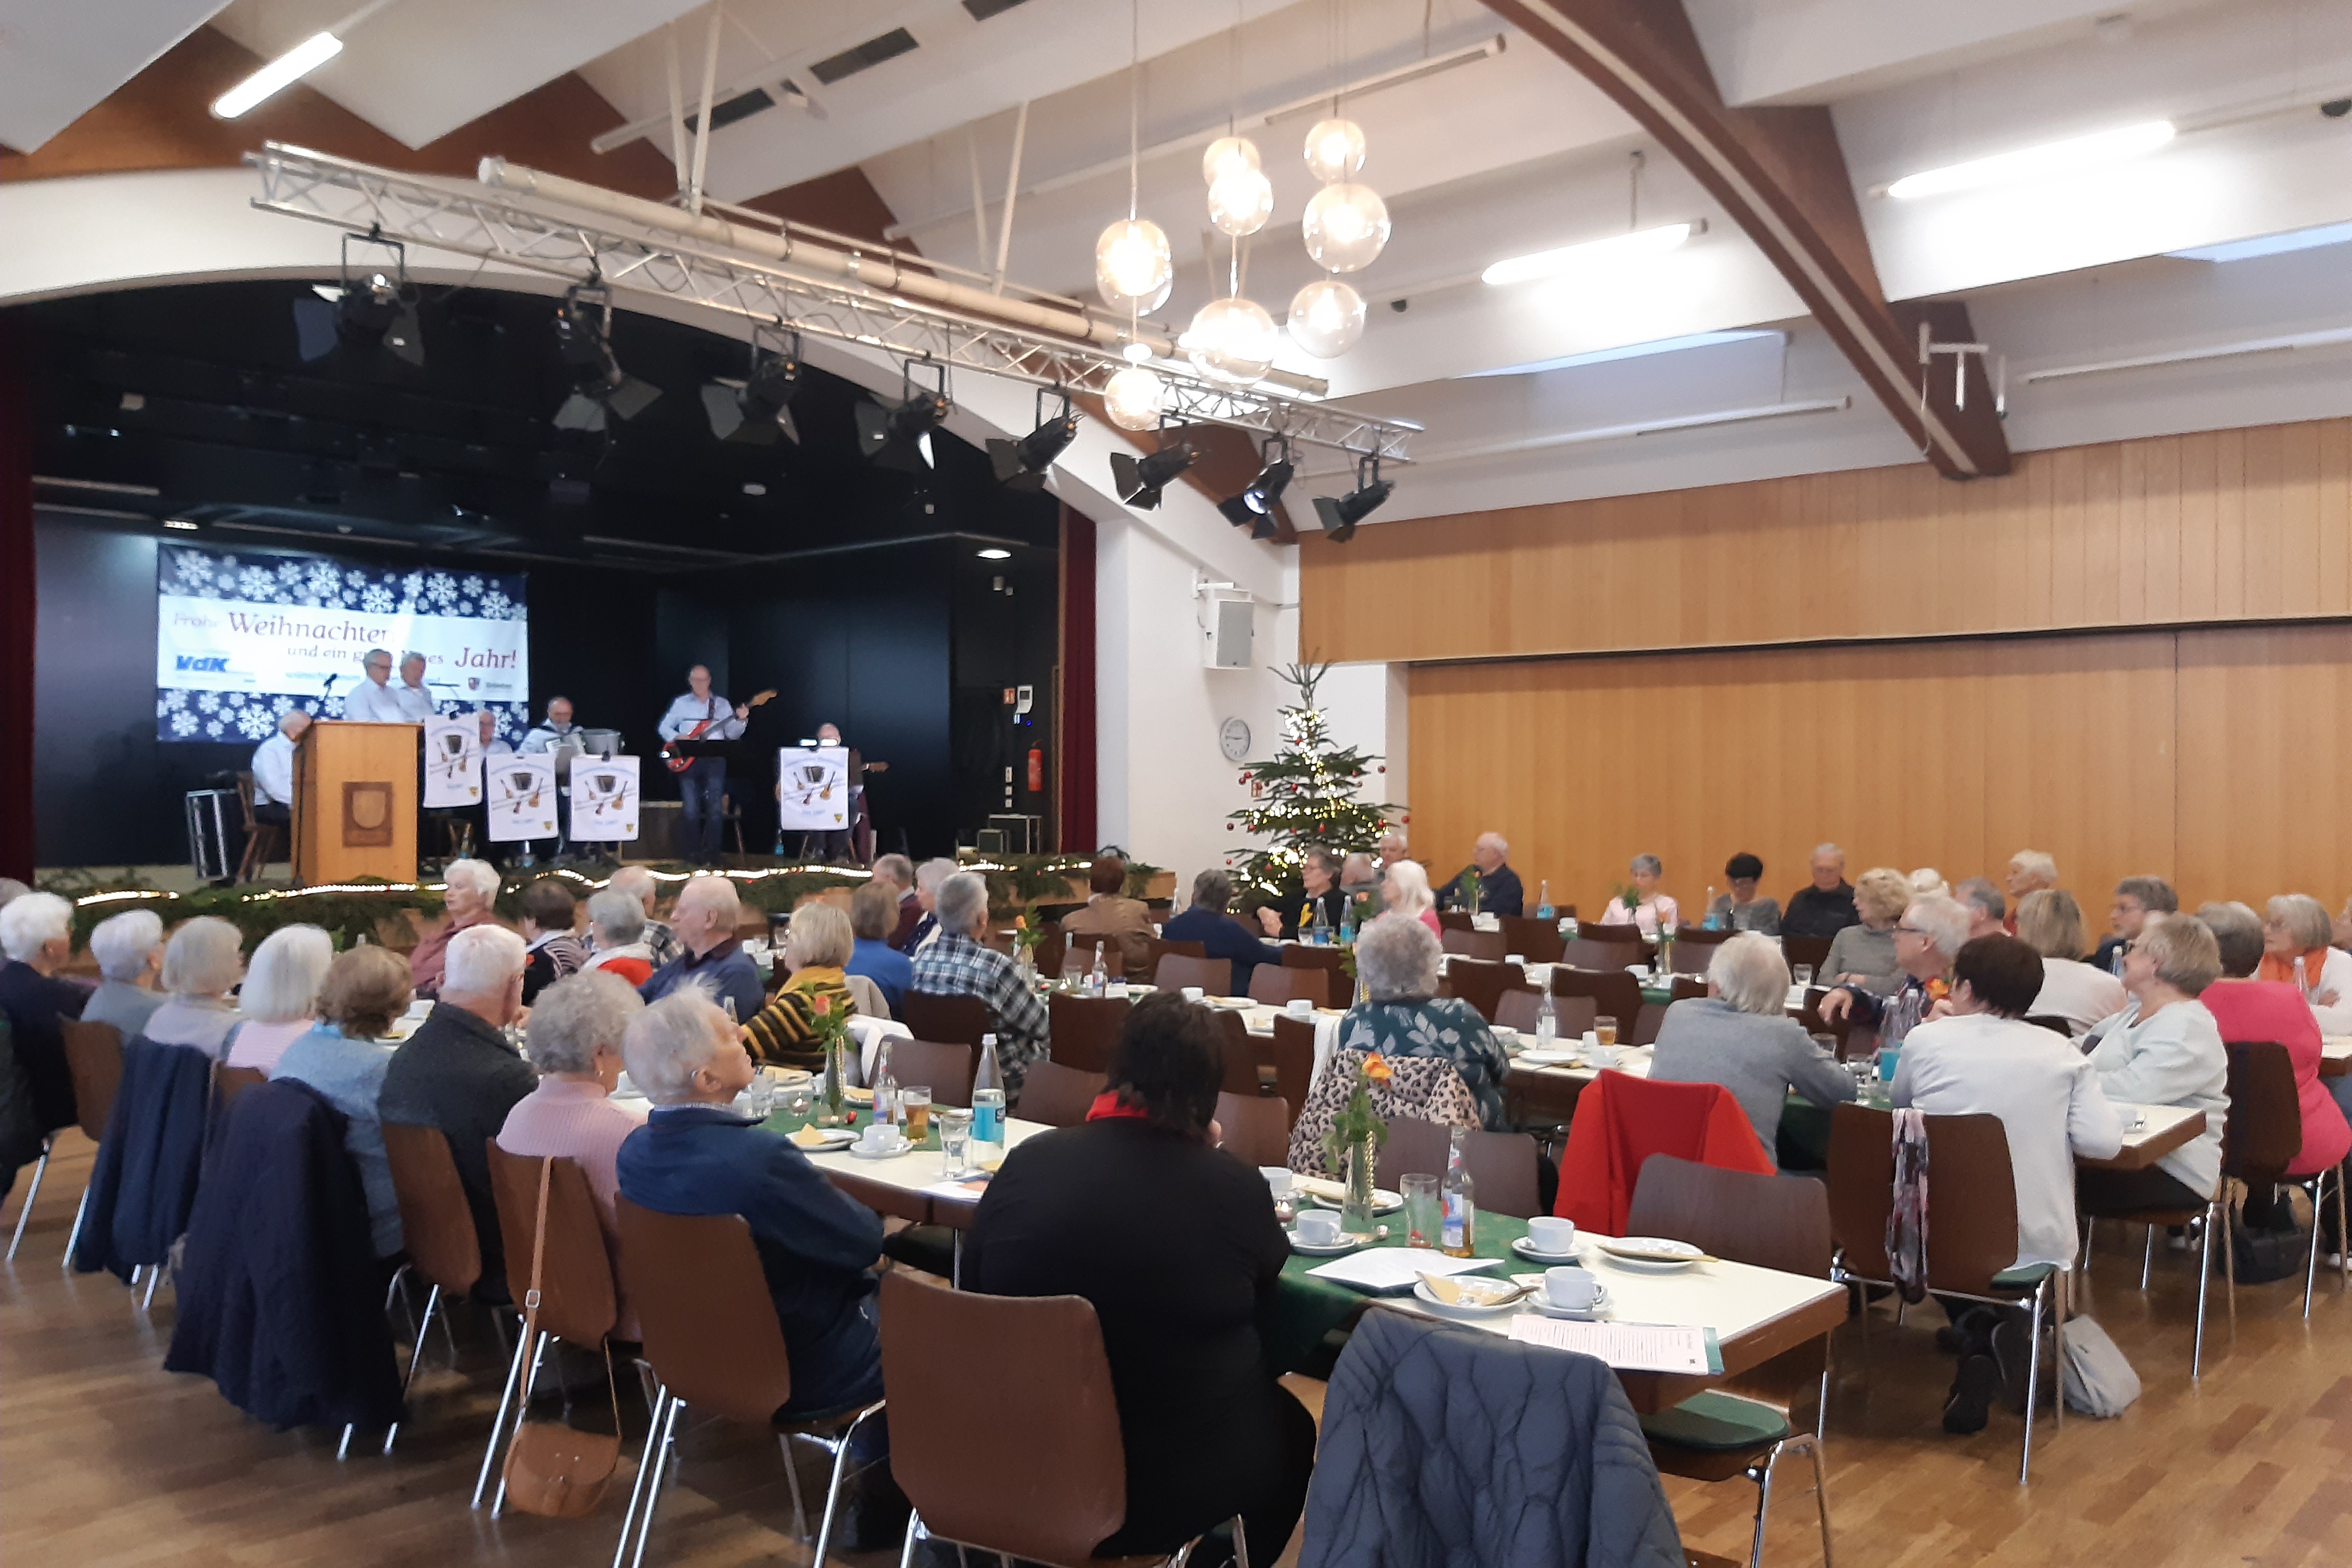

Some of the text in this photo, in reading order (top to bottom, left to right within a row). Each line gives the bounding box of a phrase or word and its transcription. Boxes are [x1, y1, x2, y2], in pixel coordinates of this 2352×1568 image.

[229, 611, 395, 644] Weihnachten
[287, 645, 318, 657] und
[323, 647, 347, 659] ein
[454, 646, 517, 668] Jahr!
